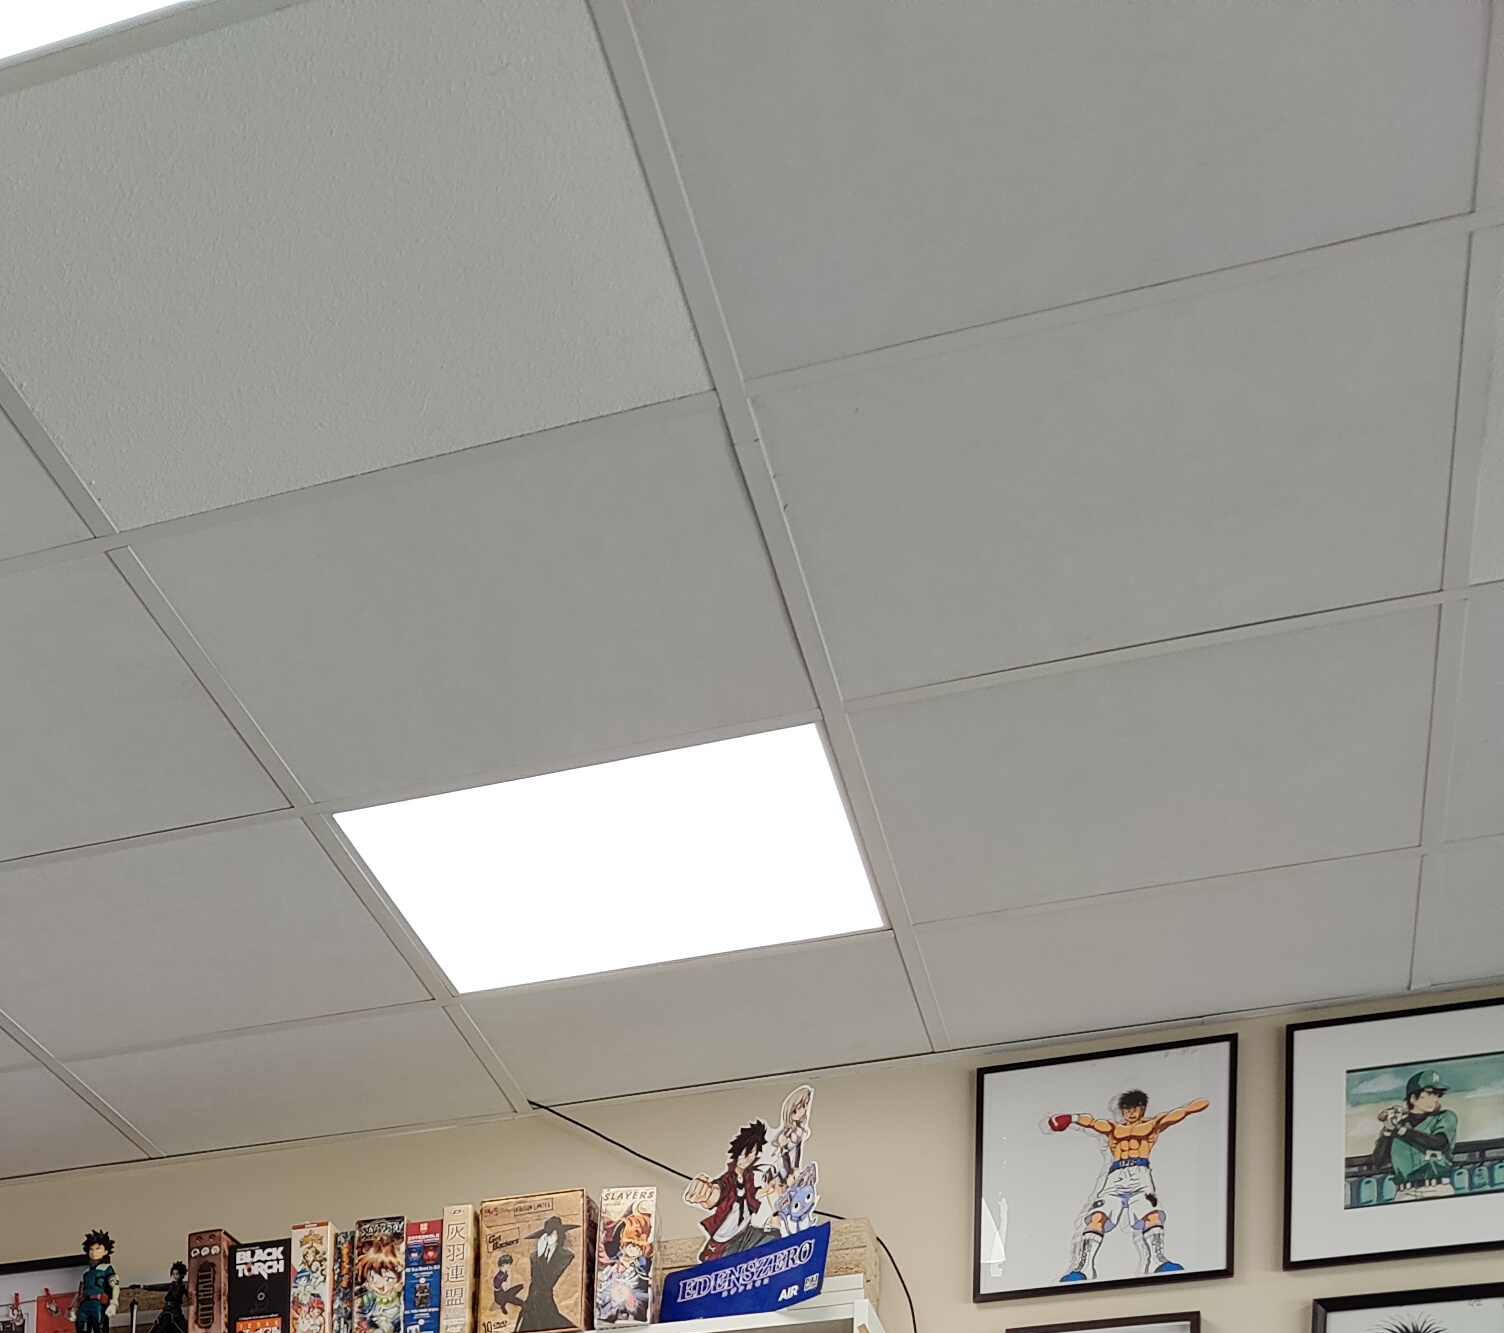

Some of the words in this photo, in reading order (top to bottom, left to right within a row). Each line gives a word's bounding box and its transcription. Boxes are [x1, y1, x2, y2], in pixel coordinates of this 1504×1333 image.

[603, 1189, 655, 1201] SLAYERS
[235, 1246, 284, 1265] BLACK
[236, 1261, 284, 1280] TORCH
